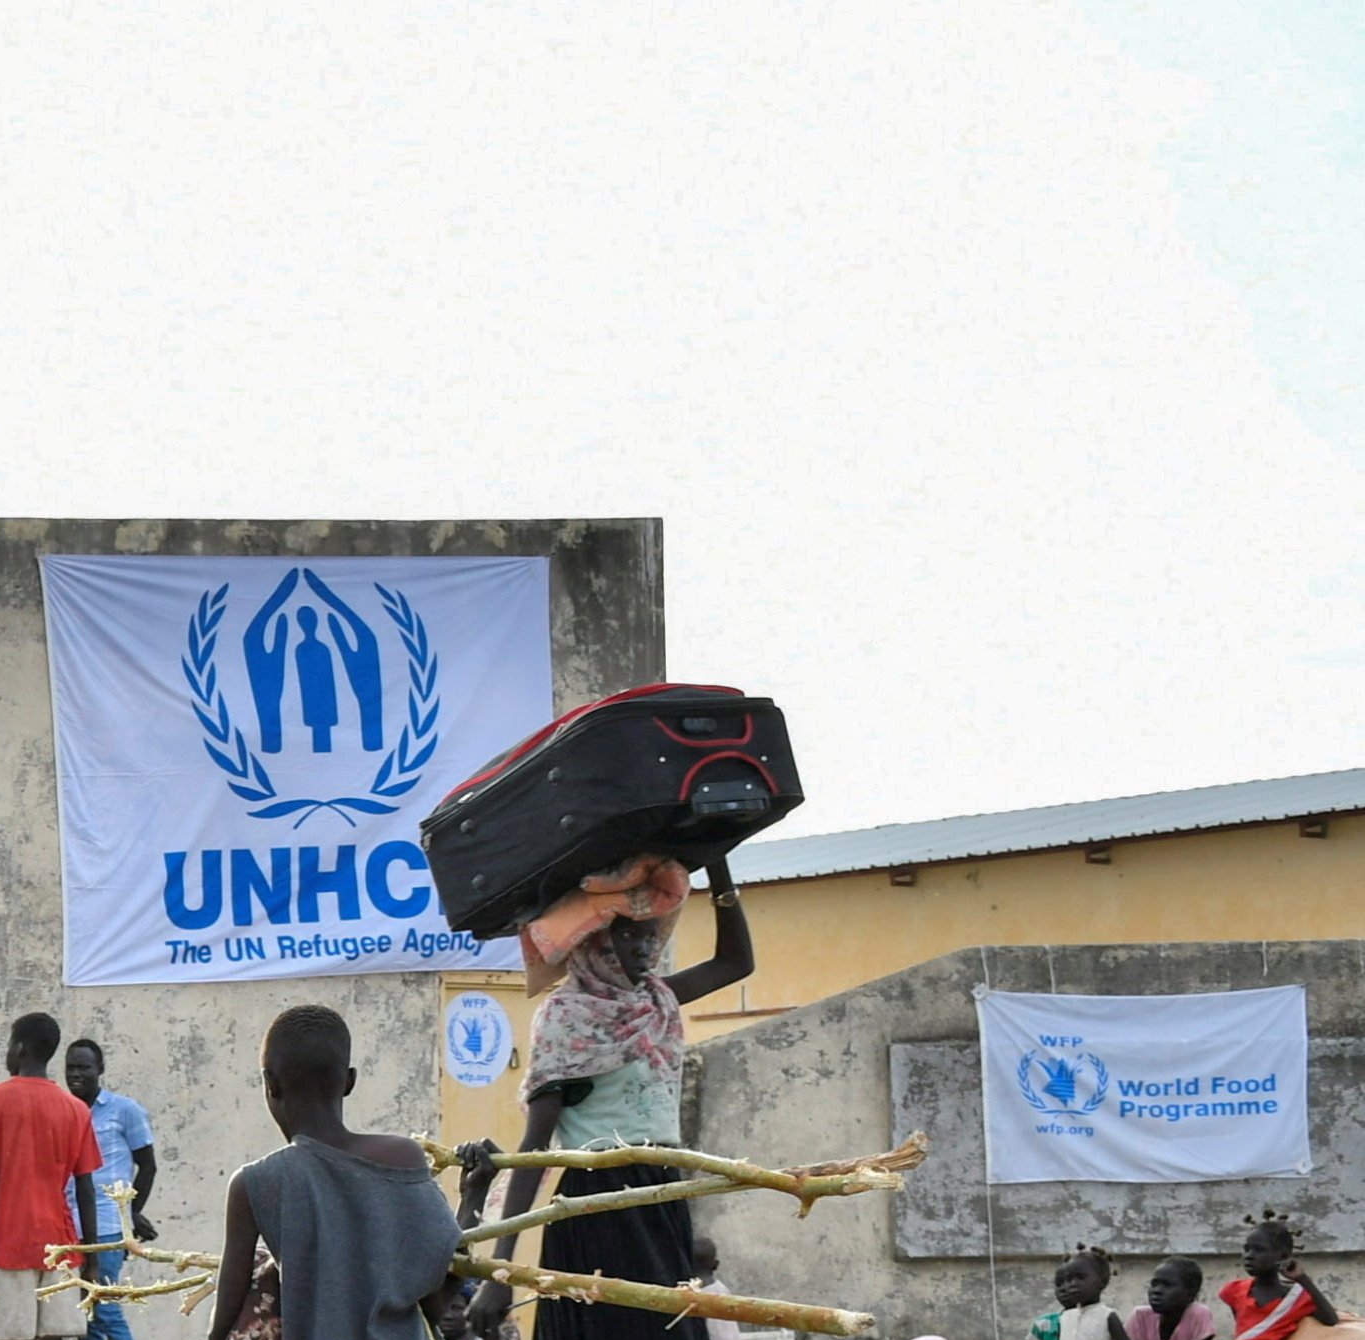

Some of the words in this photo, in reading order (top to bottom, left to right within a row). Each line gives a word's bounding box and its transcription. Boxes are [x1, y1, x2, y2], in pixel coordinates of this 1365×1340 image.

[163, 840, 448, 930] UNHC
[165, 940, 212, 965] The
[224, 937, 266, 962] UN
[276, 934, 392, 961] Refugee
[462, 998, 489, 1008] WFP
[1039, 1034, 1083, 1048] WFP
[1117, 1077, 1199, 1098] World
[1211, 1073, 1277, 1096] Food
[1119, 1098, 1278, 1122] Programme
[1036, 1122, 1095, 1138] wfp.org
